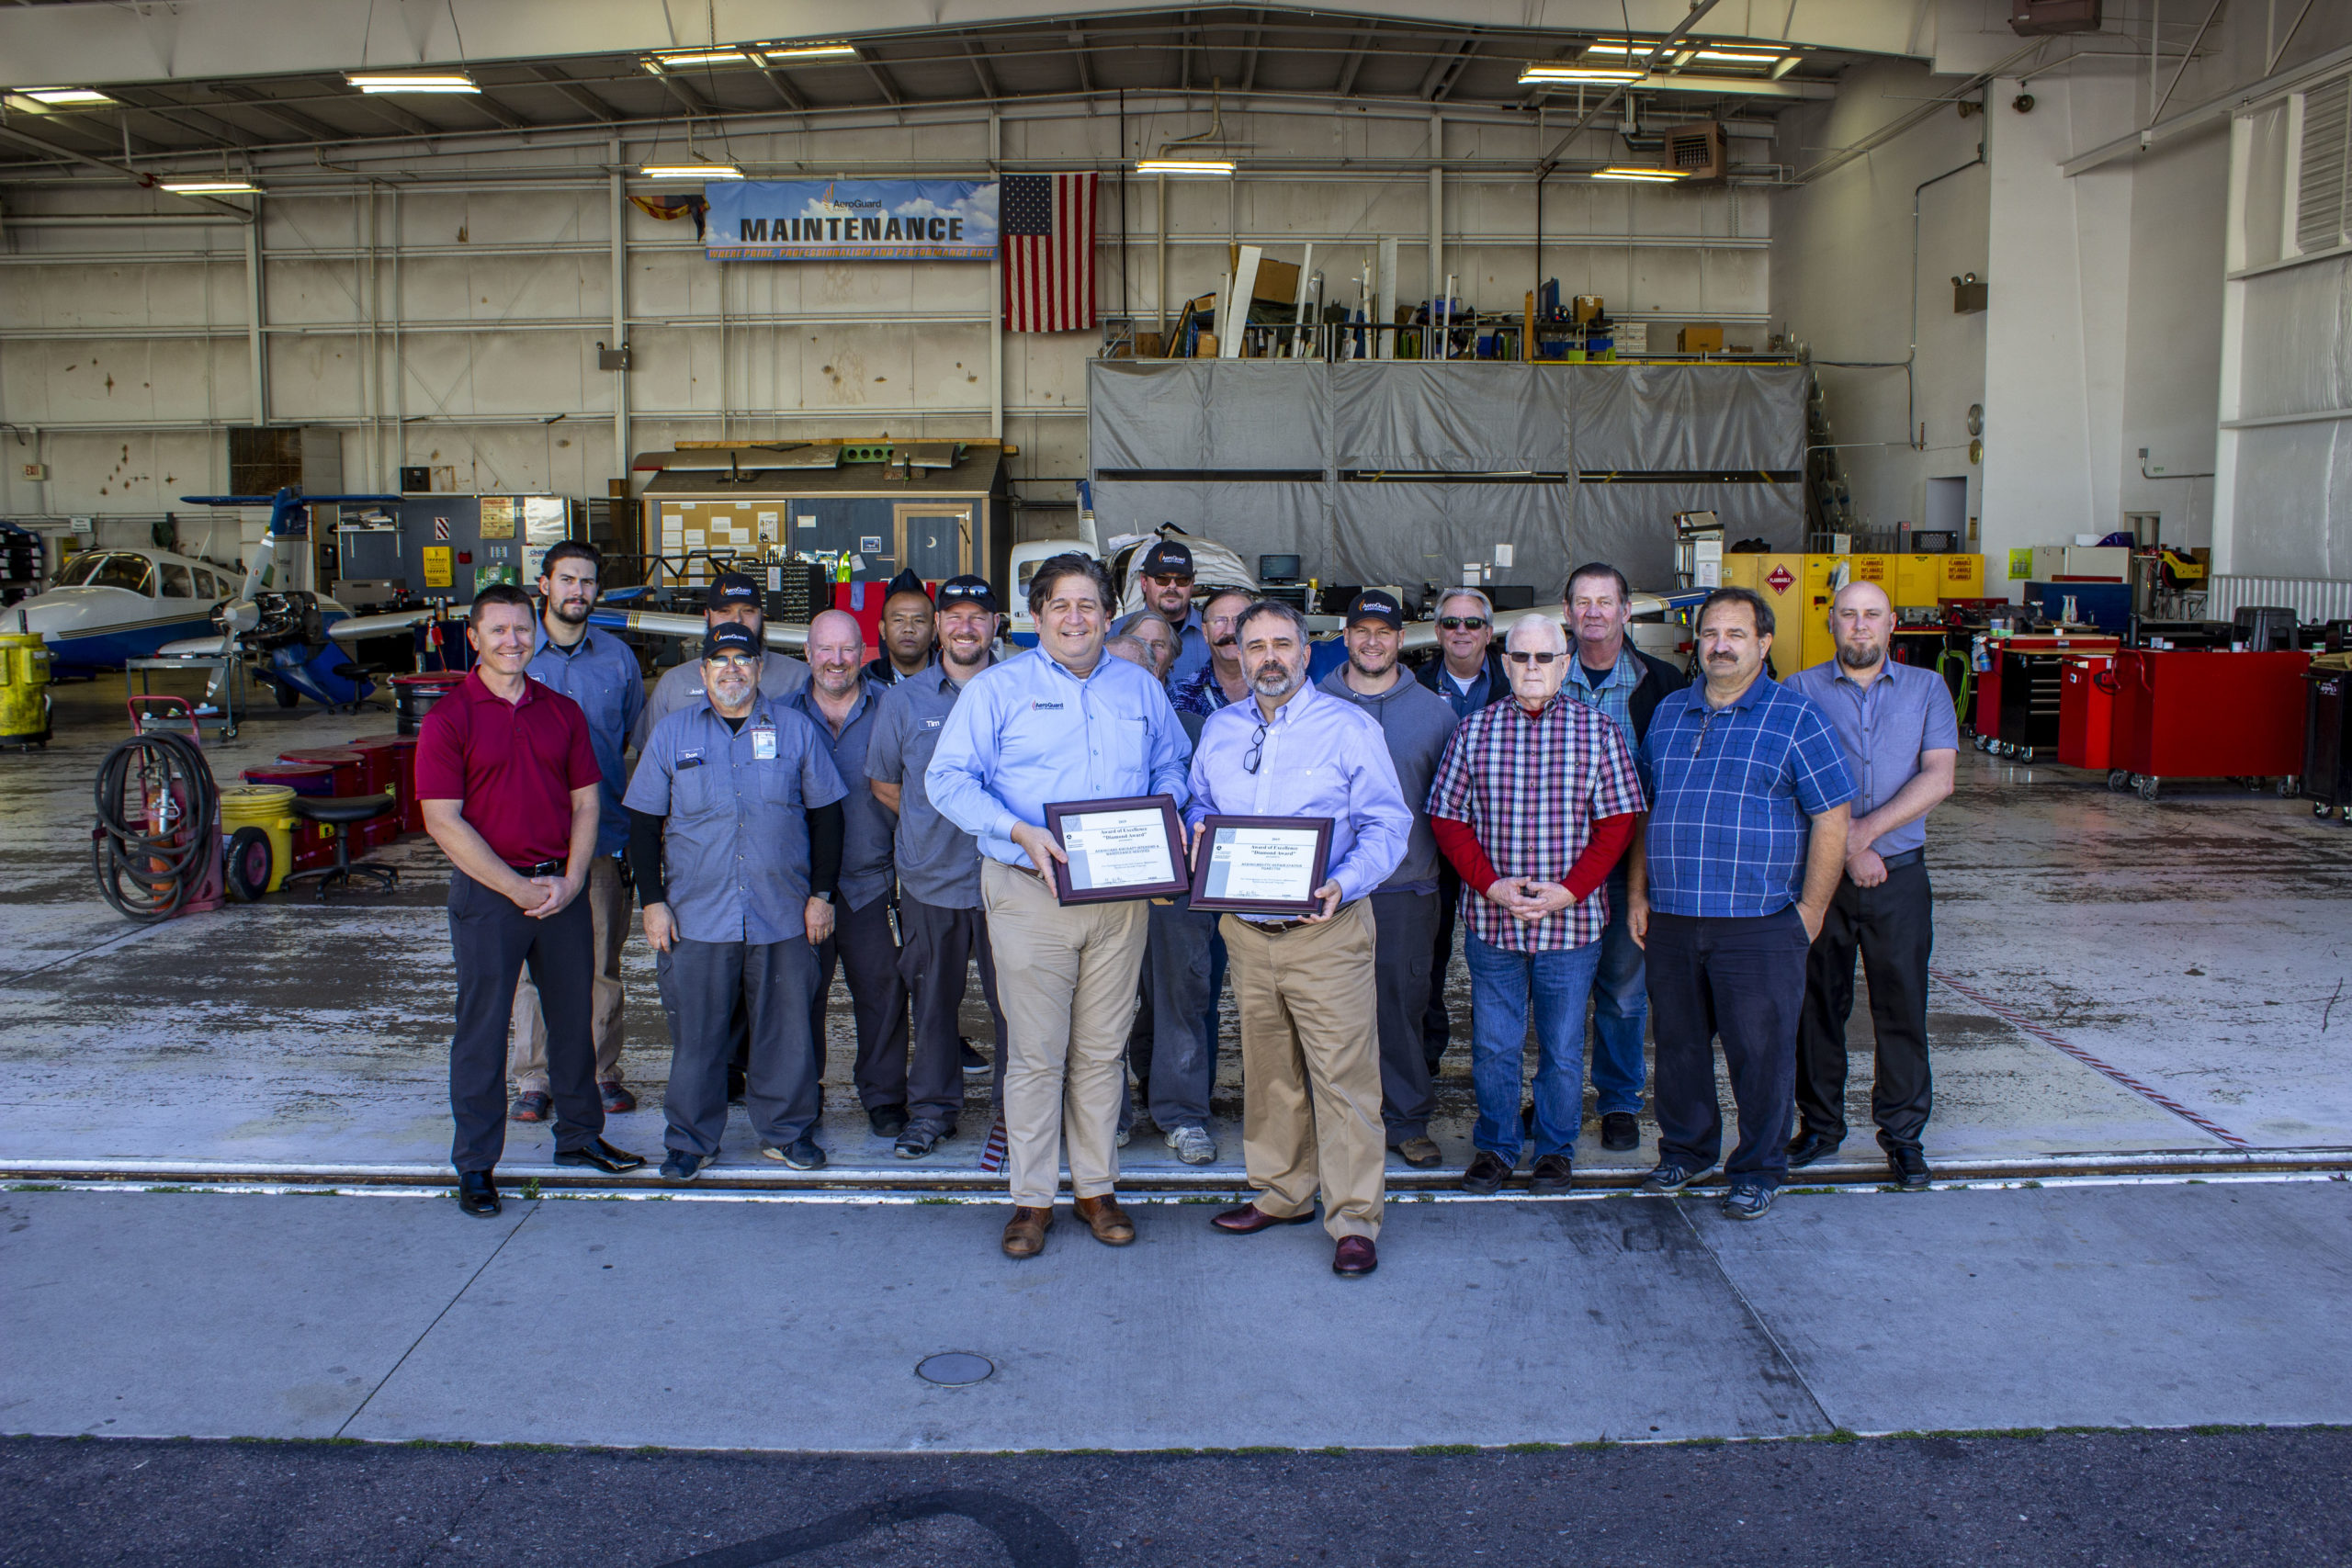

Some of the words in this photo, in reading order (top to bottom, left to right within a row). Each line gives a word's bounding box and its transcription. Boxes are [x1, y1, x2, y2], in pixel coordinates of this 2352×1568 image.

[833, 198, 882, 209] AeroGuard
[741, 217, 964, 242] MAINTENANCE
[708, 248, 742, 258] WHERE
[743, 248, 776, 258] PRIDE,
[779, 248, 872, 258] PROFESSIONALISM
[873, 248, 894, 258] AND
[896, 248, 968, 258] PERFORMANCE
[970, 248, 994, 258] RULE
[725, 586, 752, 594] AeroGuard
[1363, 603, 1392, 612] AeroGuard
[718, 634, 748, 642] AeroGuard
